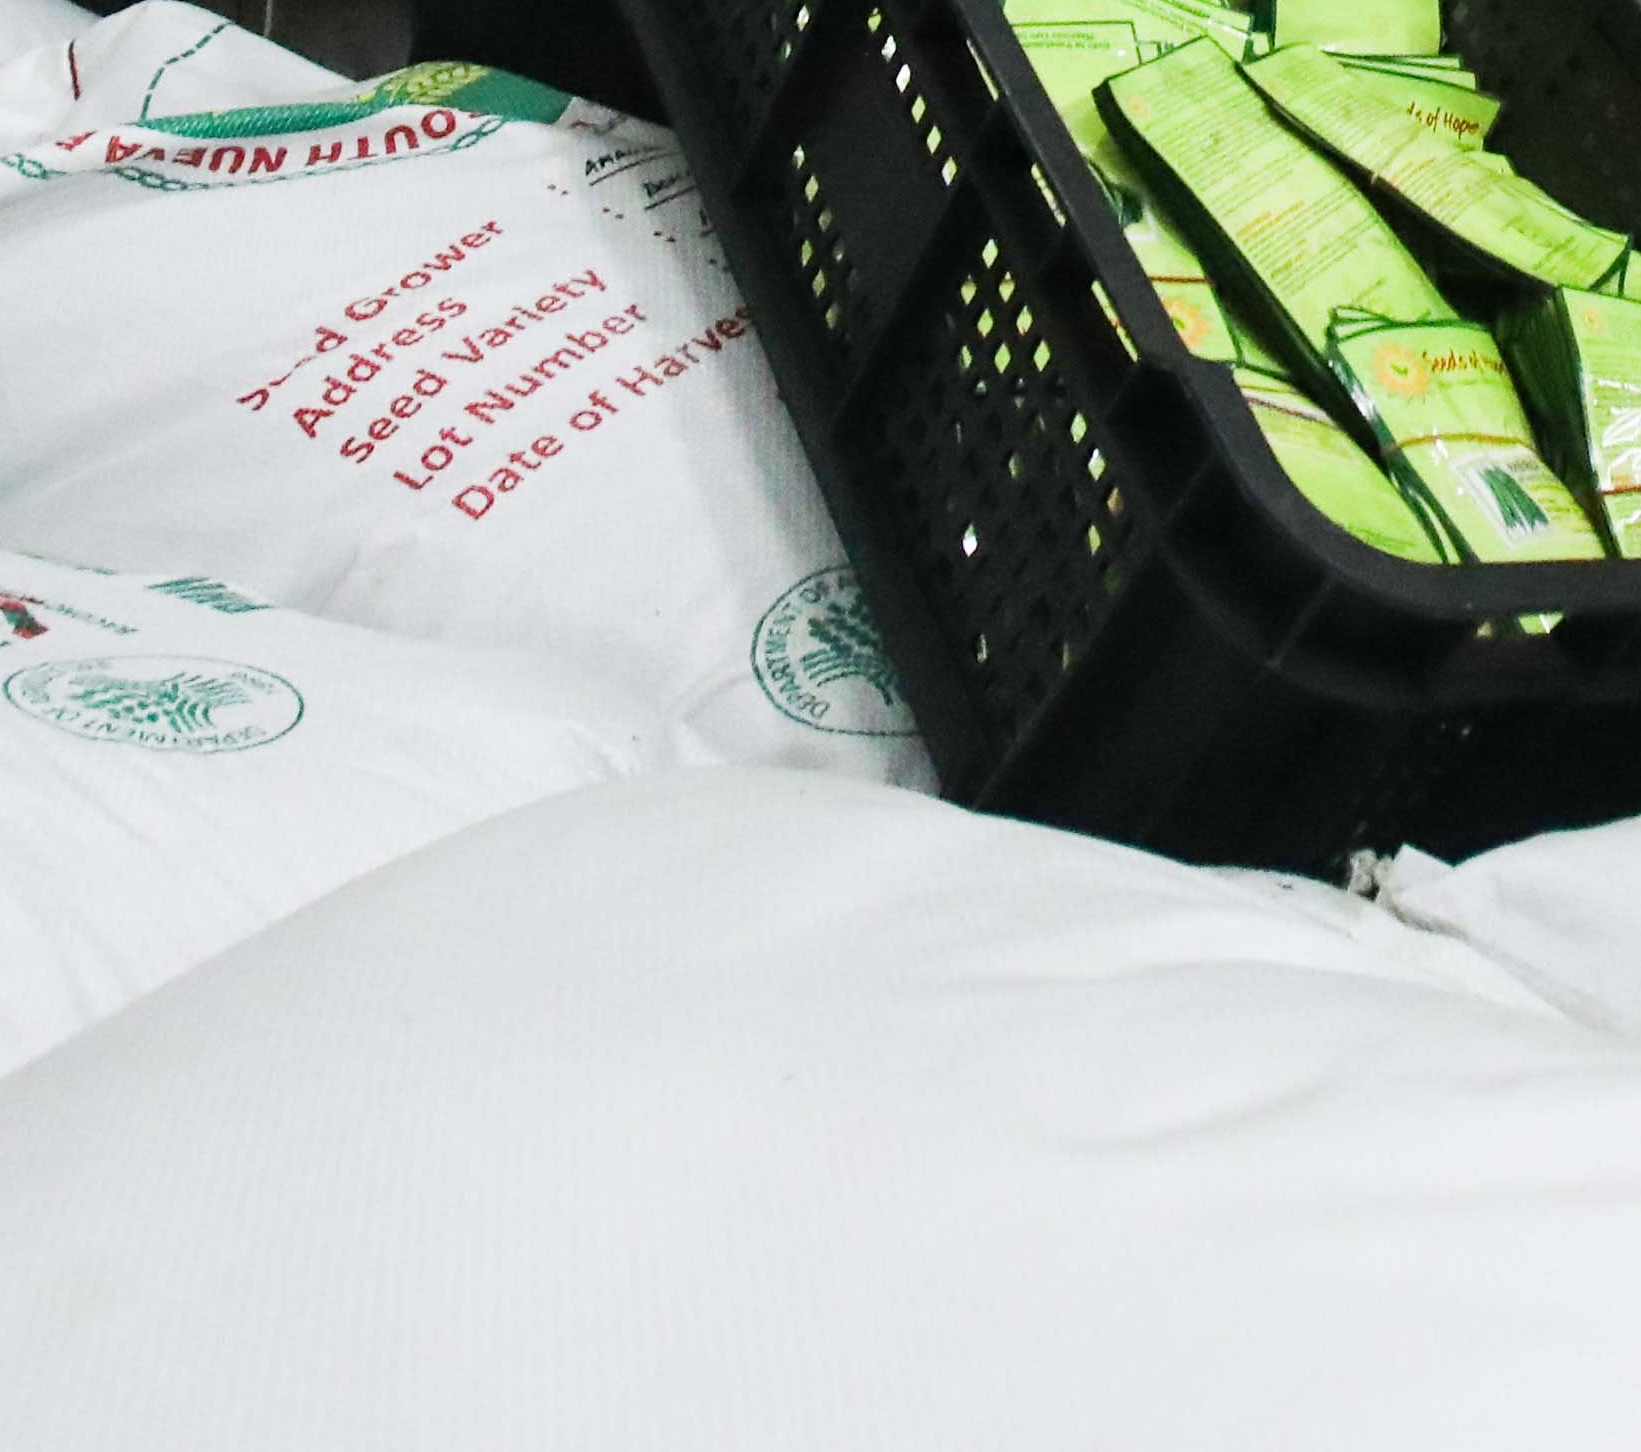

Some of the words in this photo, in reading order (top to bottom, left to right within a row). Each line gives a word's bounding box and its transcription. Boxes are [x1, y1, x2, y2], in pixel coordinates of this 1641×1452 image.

[305, 107, 480, 169] OUTH
[344, 219, 506, 324] Grower
[292, 295, 469, 439] Address
[339, 368, 448, 464] Seed
[441, 266, 608, 366] Variety
[392, 424, 474, 491] Lot
[463, 302, 650, 426] Number
[451, 431, 565, 522] Date
[569, 389, 621, 433] of
